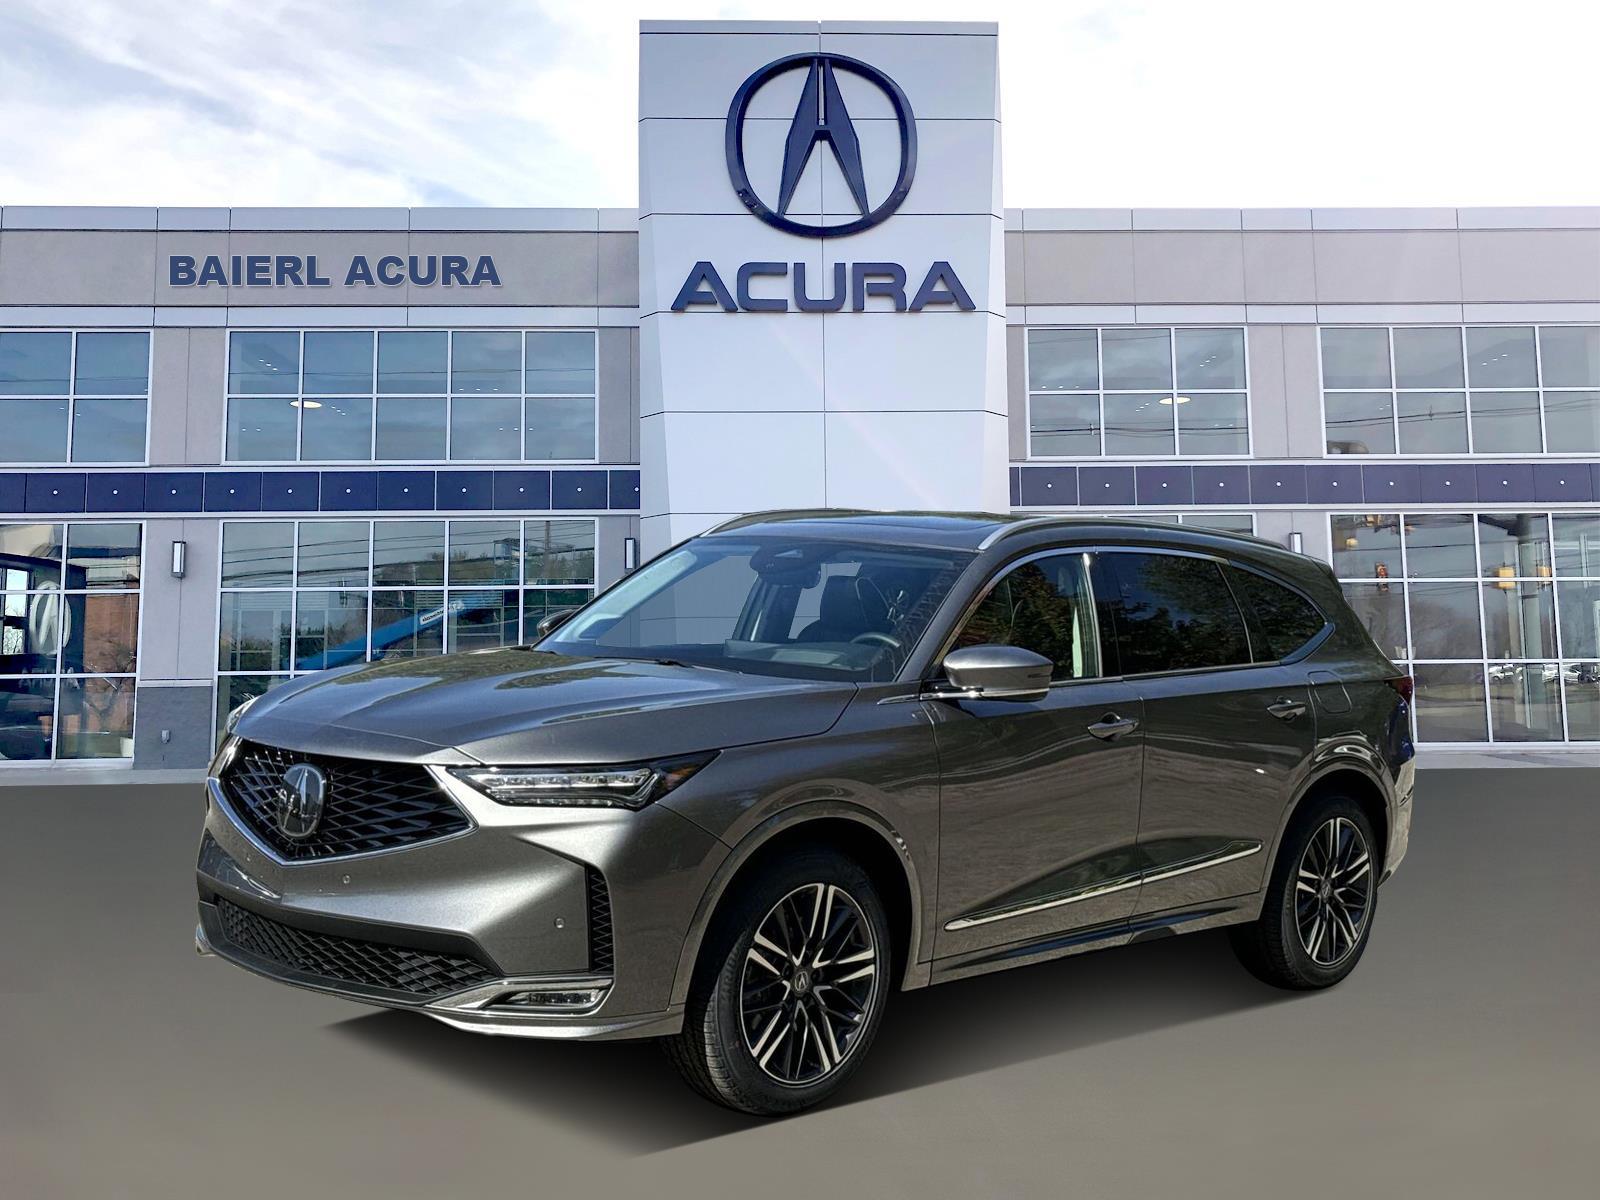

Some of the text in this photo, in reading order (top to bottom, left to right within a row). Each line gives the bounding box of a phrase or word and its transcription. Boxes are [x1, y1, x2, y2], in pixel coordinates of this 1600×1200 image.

[169, 255, 501, 286] BAIERL ACURA
[671, 261, 976, 312] ACURA
